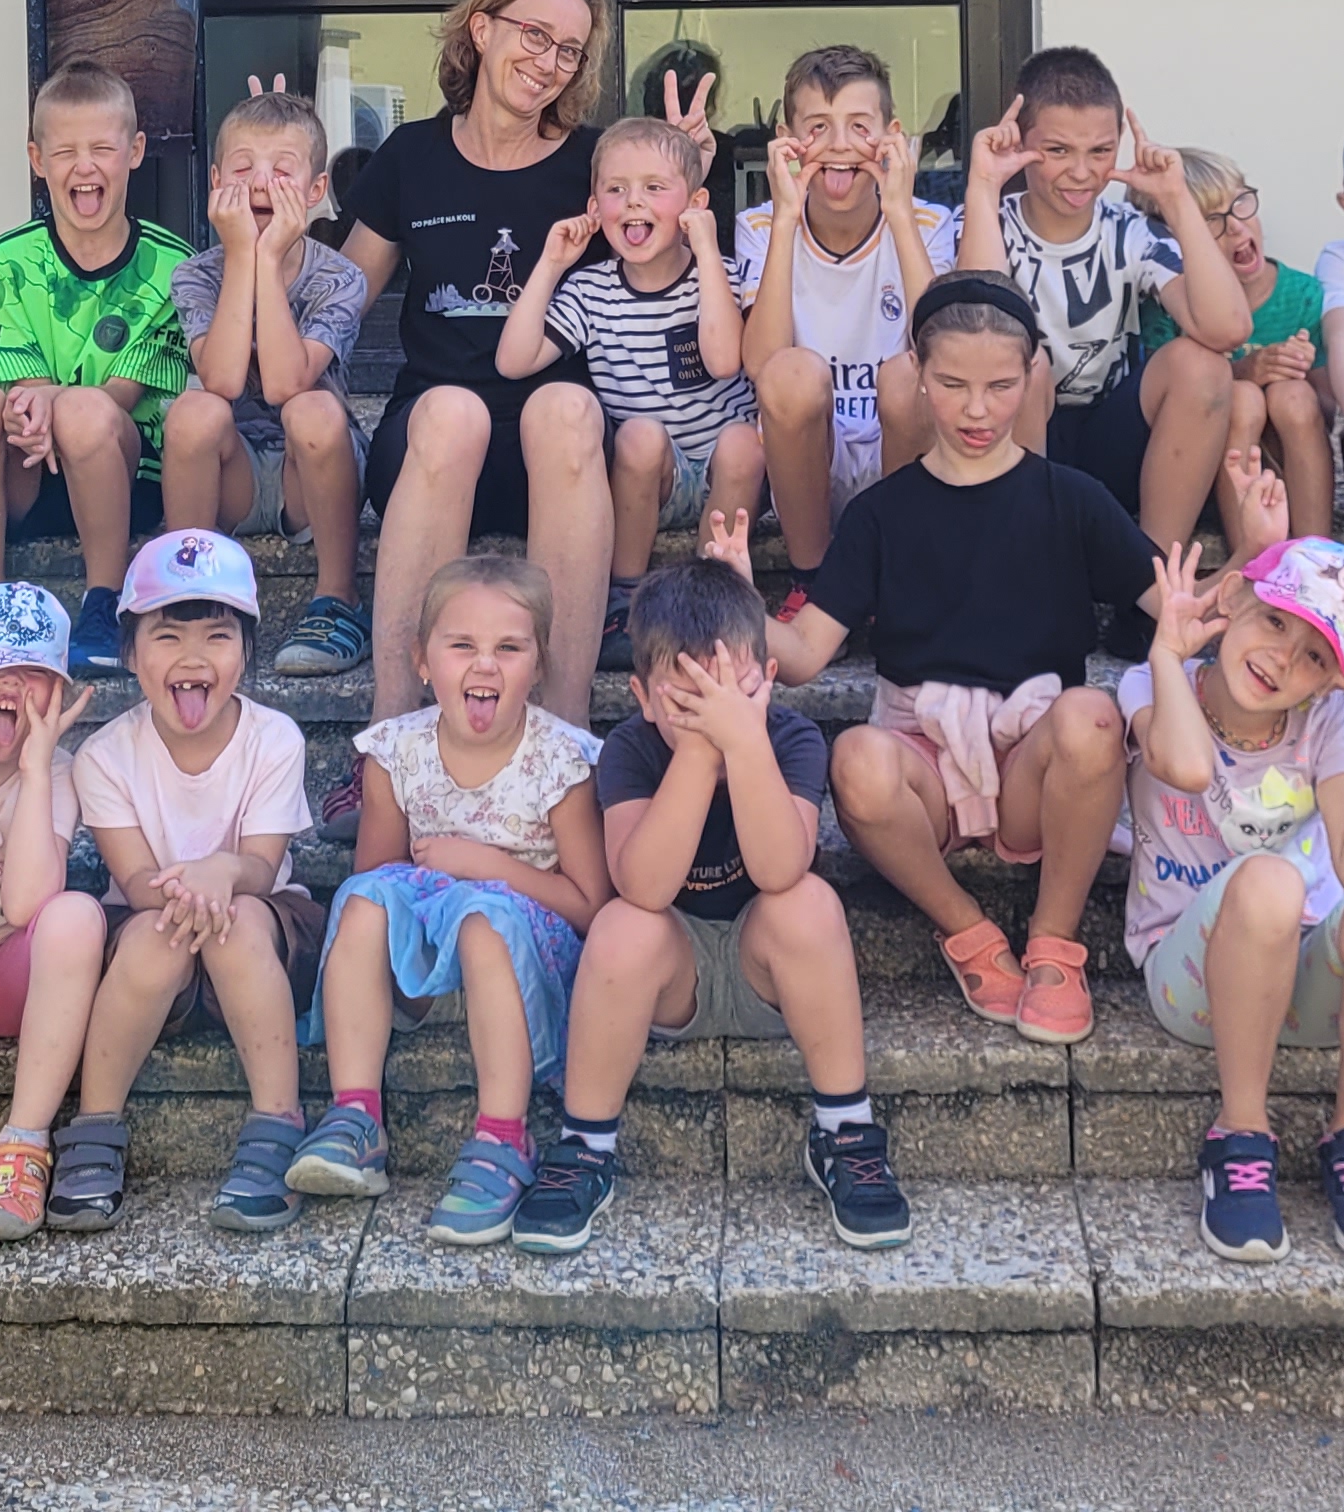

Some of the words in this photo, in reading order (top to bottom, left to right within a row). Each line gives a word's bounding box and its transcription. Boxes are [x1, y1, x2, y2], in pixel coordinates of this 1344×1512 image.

[411, 220, 423, 229] DO
[445, 215, 456, 224] NA
[456, 213, 476, 222] KOLE
[673, 340, 697, 353] GOOD
[678, 368, 703, 380] ONLY
